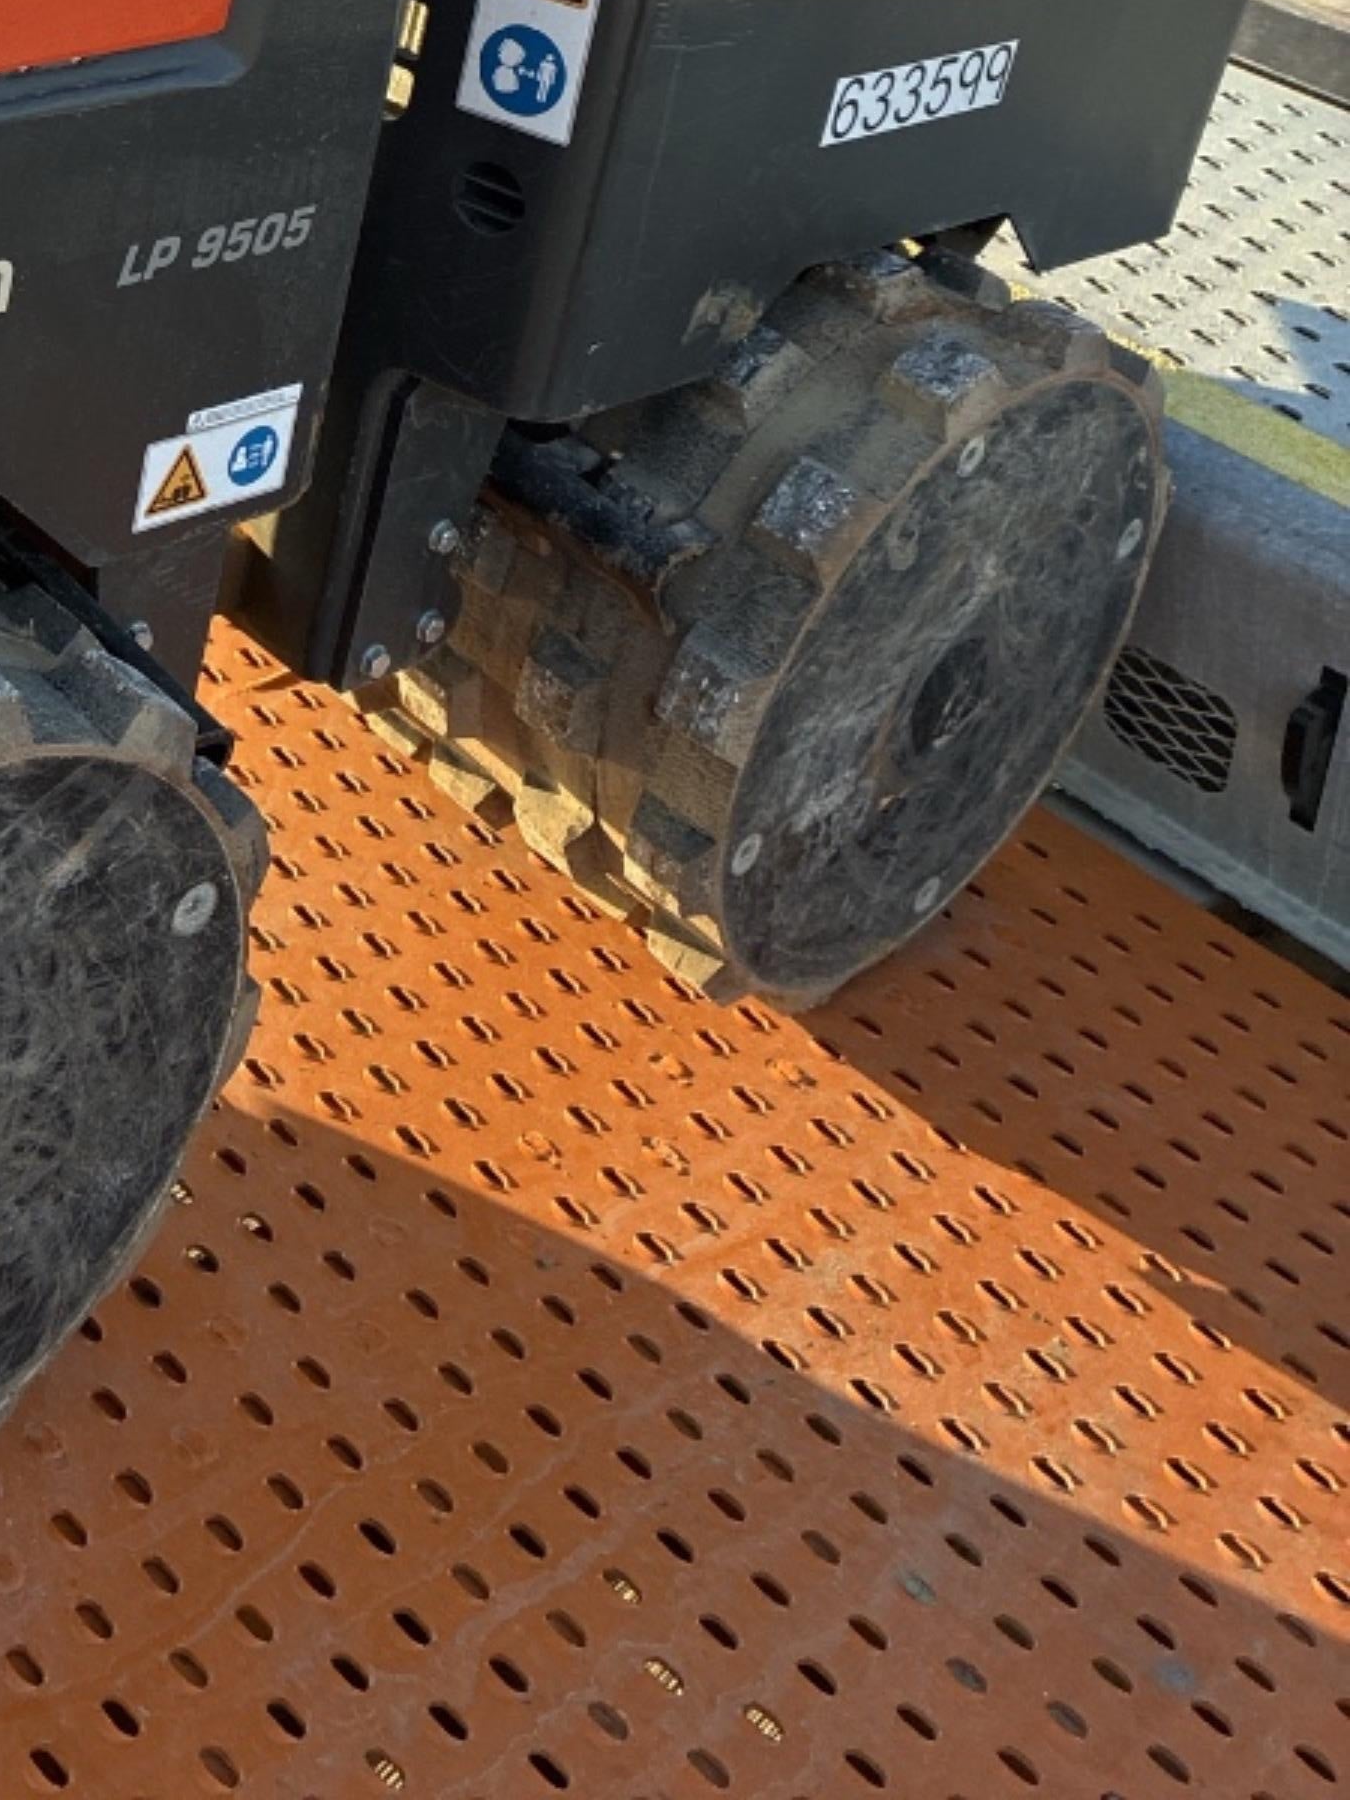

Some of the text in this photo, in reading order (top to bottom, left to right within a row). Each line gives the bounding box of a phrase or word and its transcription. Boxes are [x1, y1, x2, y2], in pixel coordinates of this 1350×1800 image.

[830, 44, 1012, 139] 633599
[115, 203, 317, 289] LP 9505
